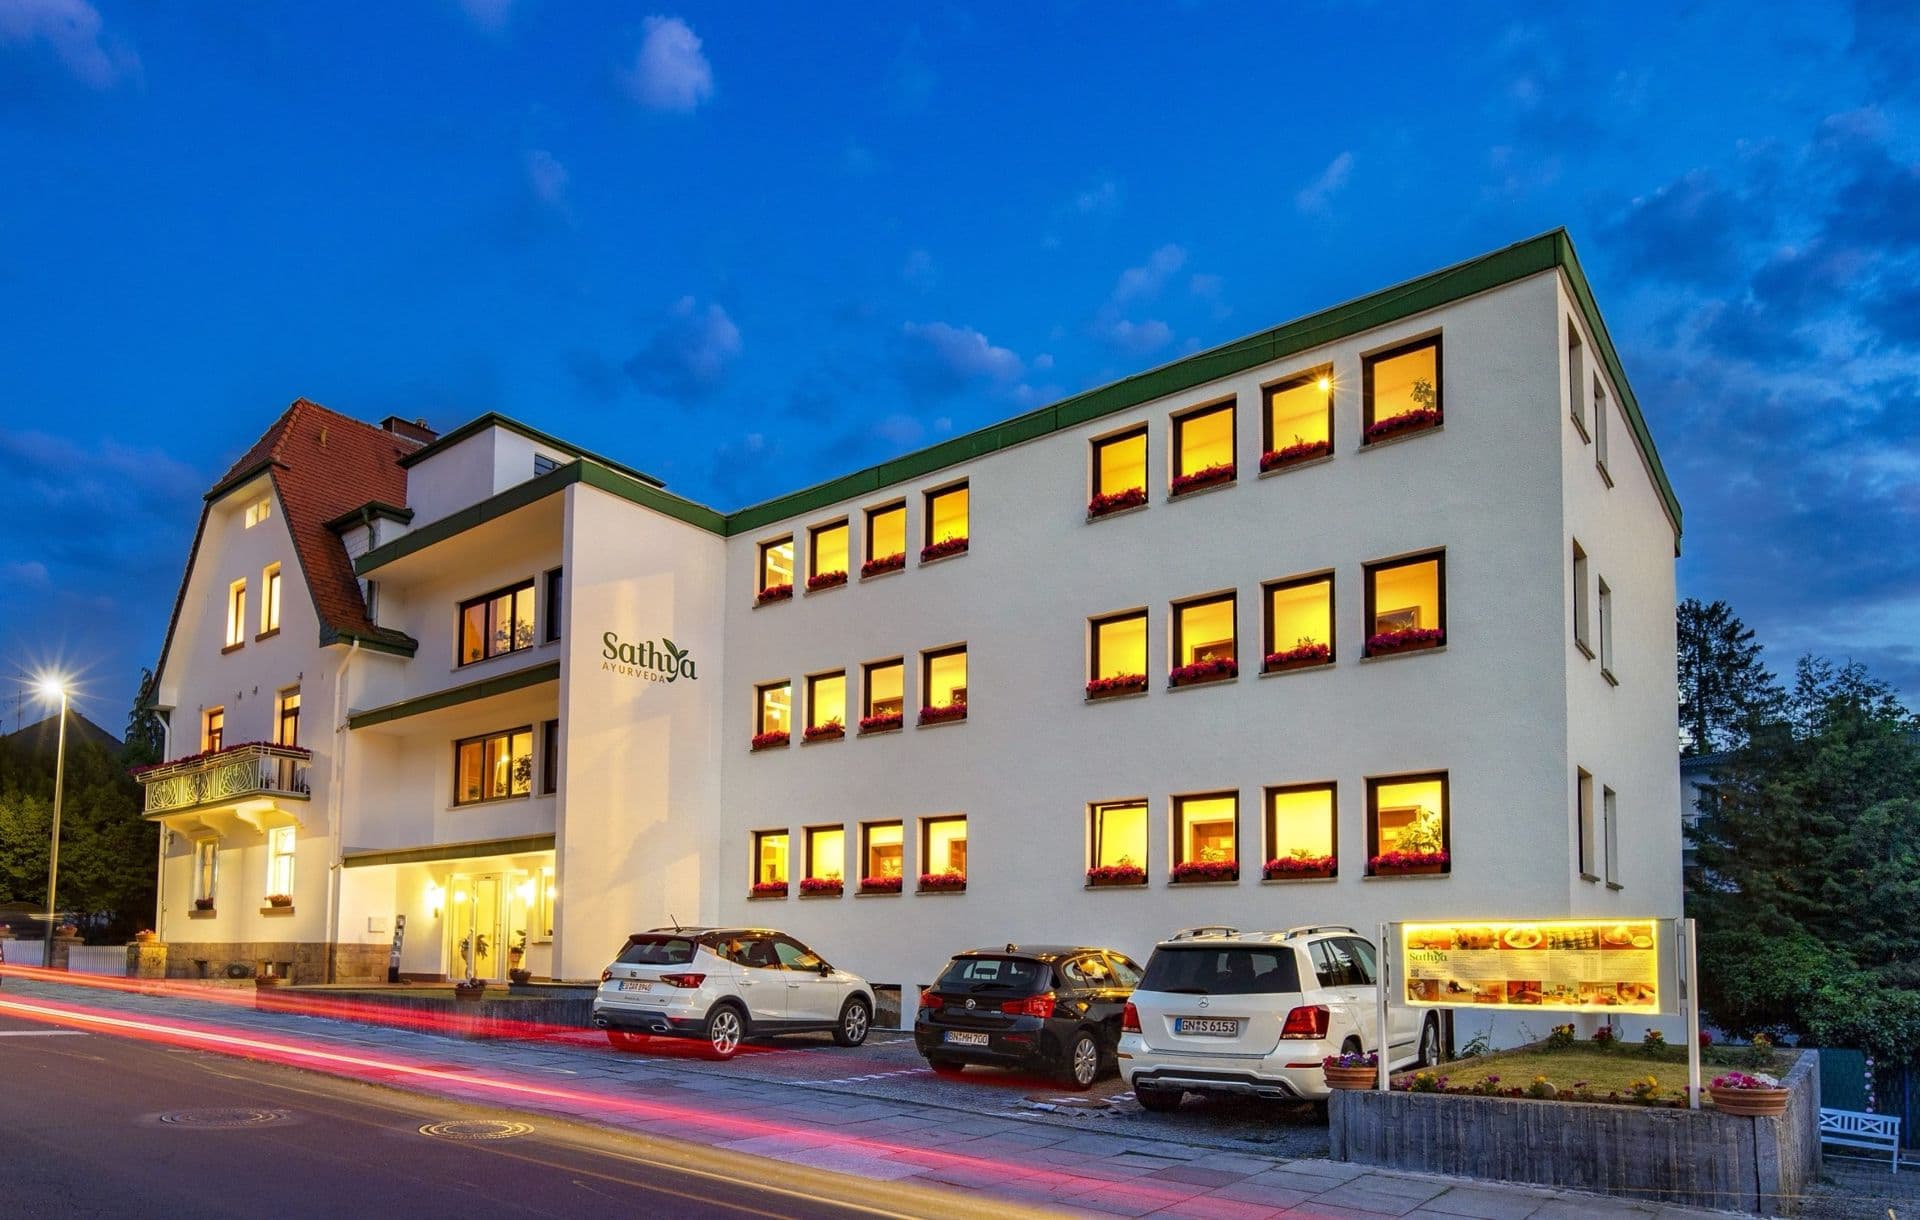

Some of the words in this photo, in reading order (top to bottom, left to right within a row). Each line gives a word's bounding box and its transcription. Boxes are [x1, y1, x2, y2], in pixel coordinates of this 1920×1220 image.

[603, 631, 698, 683] Sathya
[602, 661, 665, 683] AYURVEDA
[1410, 950, 1448, 964] Sathya
[1182, 1020, 1195, 1031] GN
[1201, 1020, 1208, 1031] S
[1210, 1021, 1235, 1032] 6153
